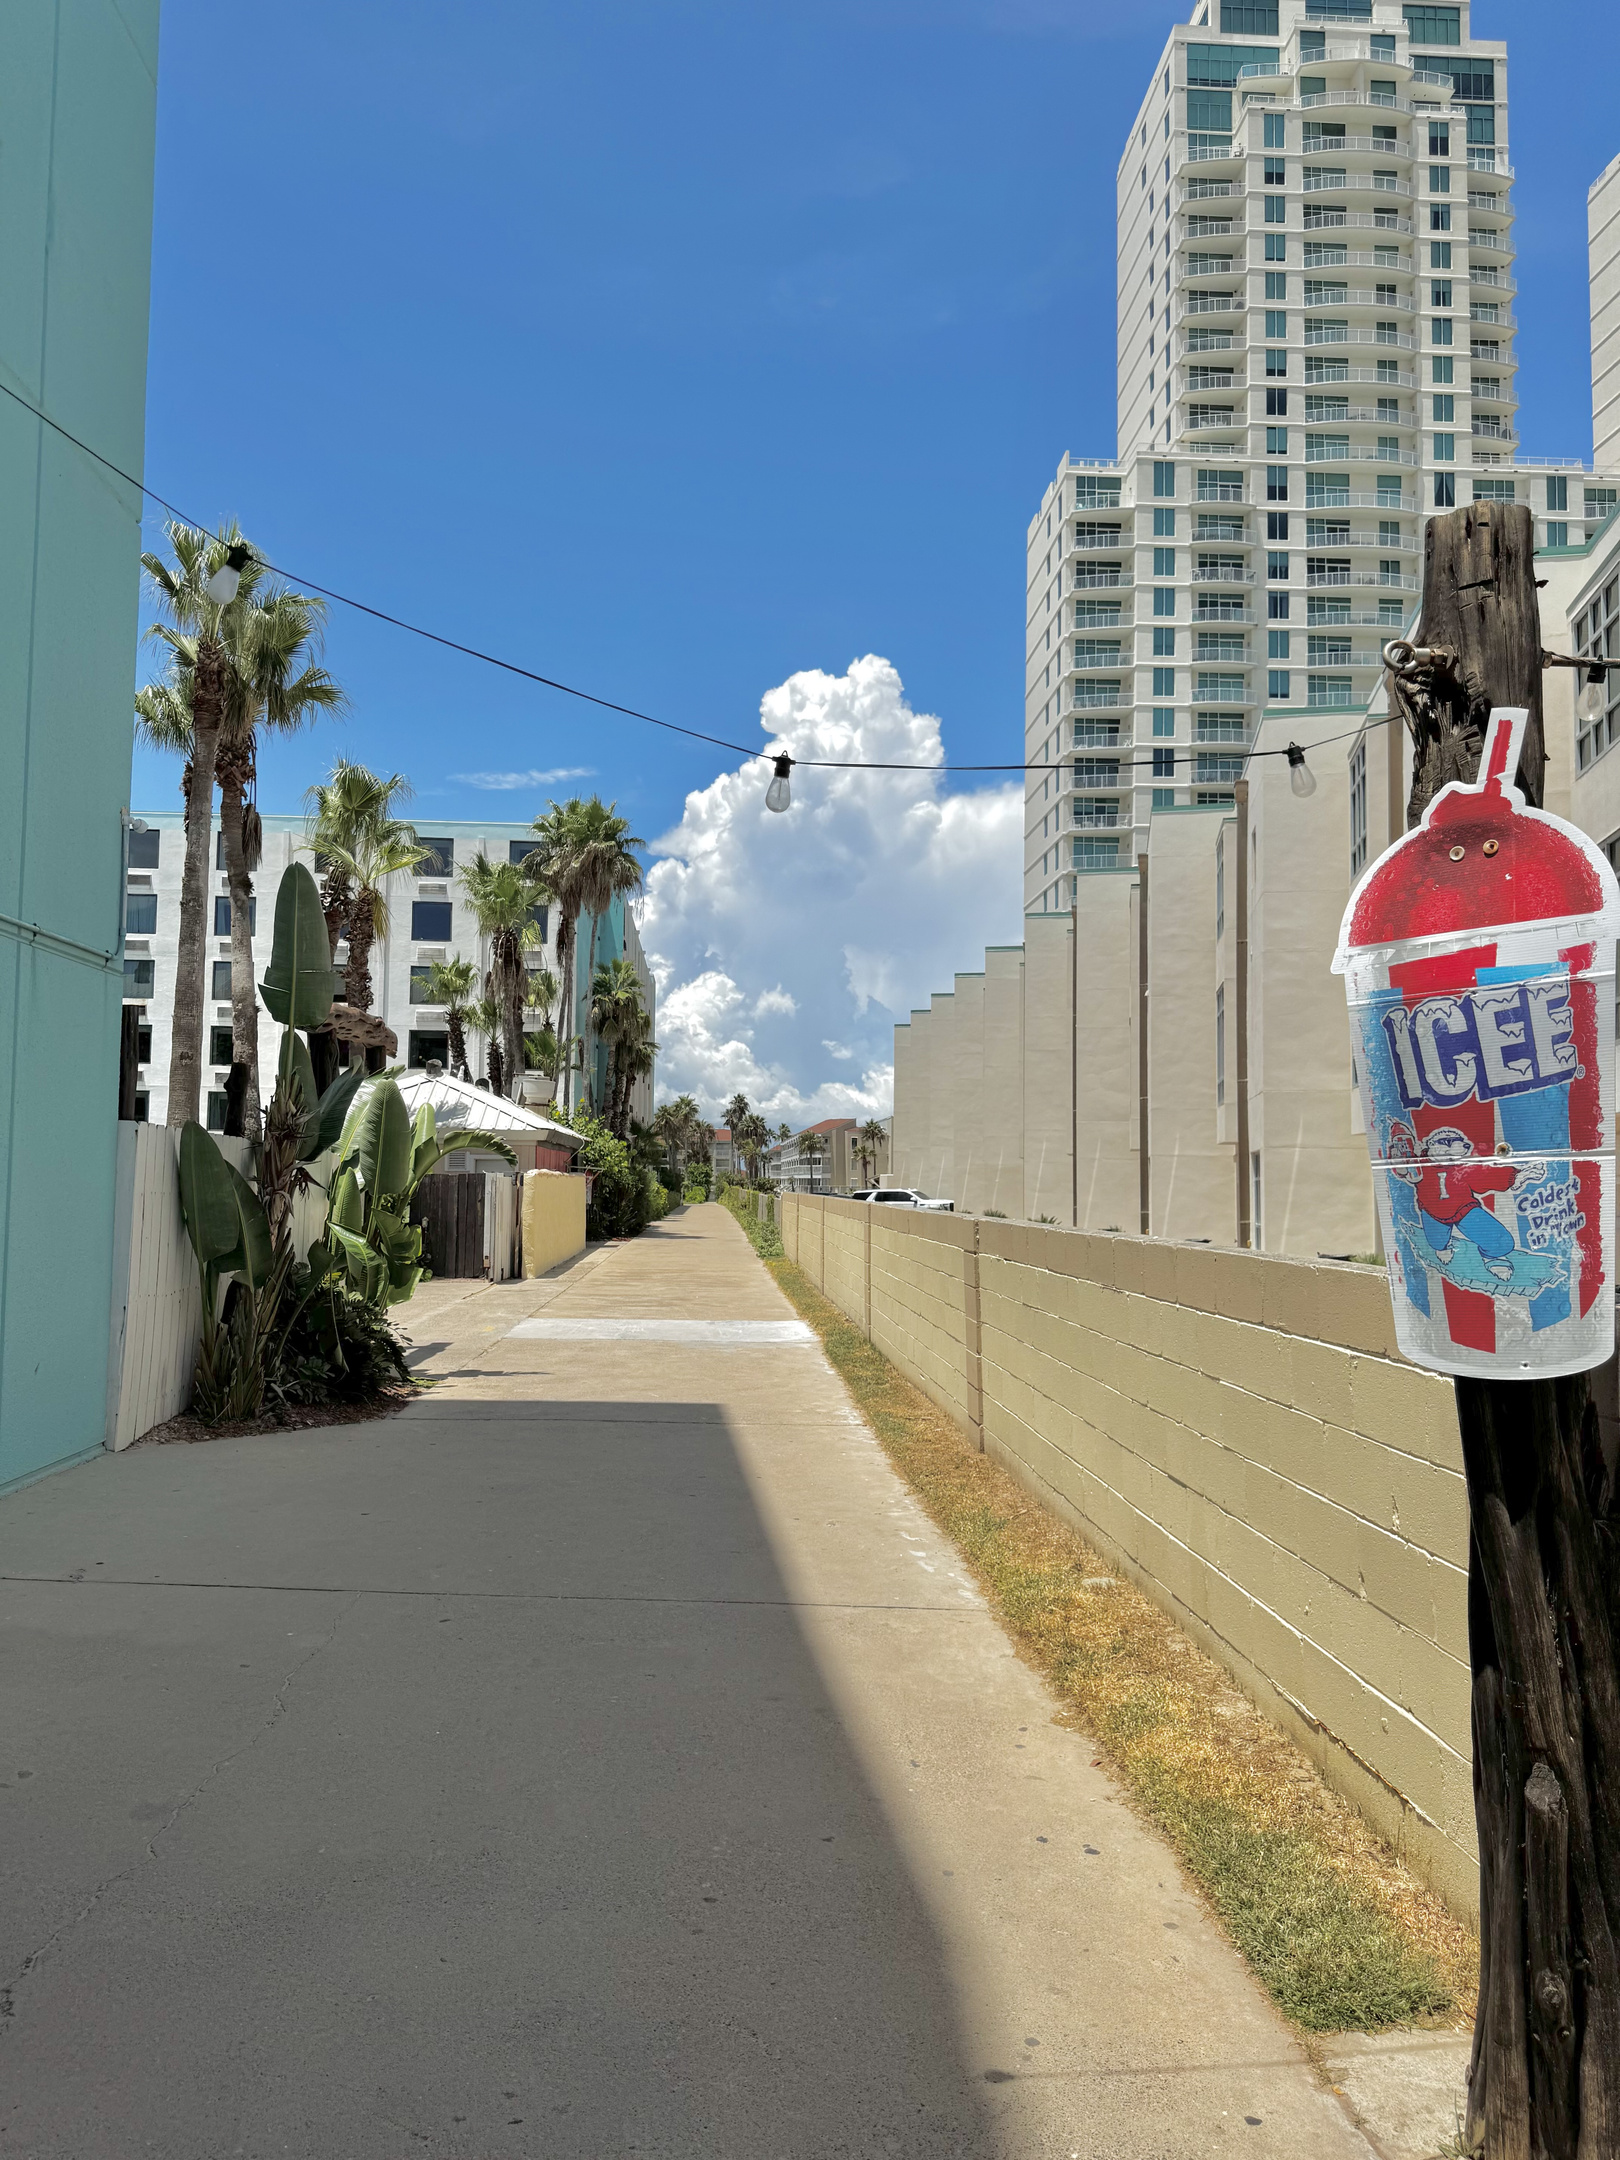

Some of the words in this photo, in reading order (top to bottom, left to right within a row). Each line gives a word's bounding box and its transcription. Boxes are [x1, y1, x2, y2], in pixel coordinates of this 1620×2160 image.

[1383, 974, 1577, 1108] ICEE
[1437, 1172, 1450, 1200] I
[1518, 1178, 1579, 1212] Coldest
[1532, 1198, 1575, 1229] Drink
[1529, 1232, 1547, 1245] in
